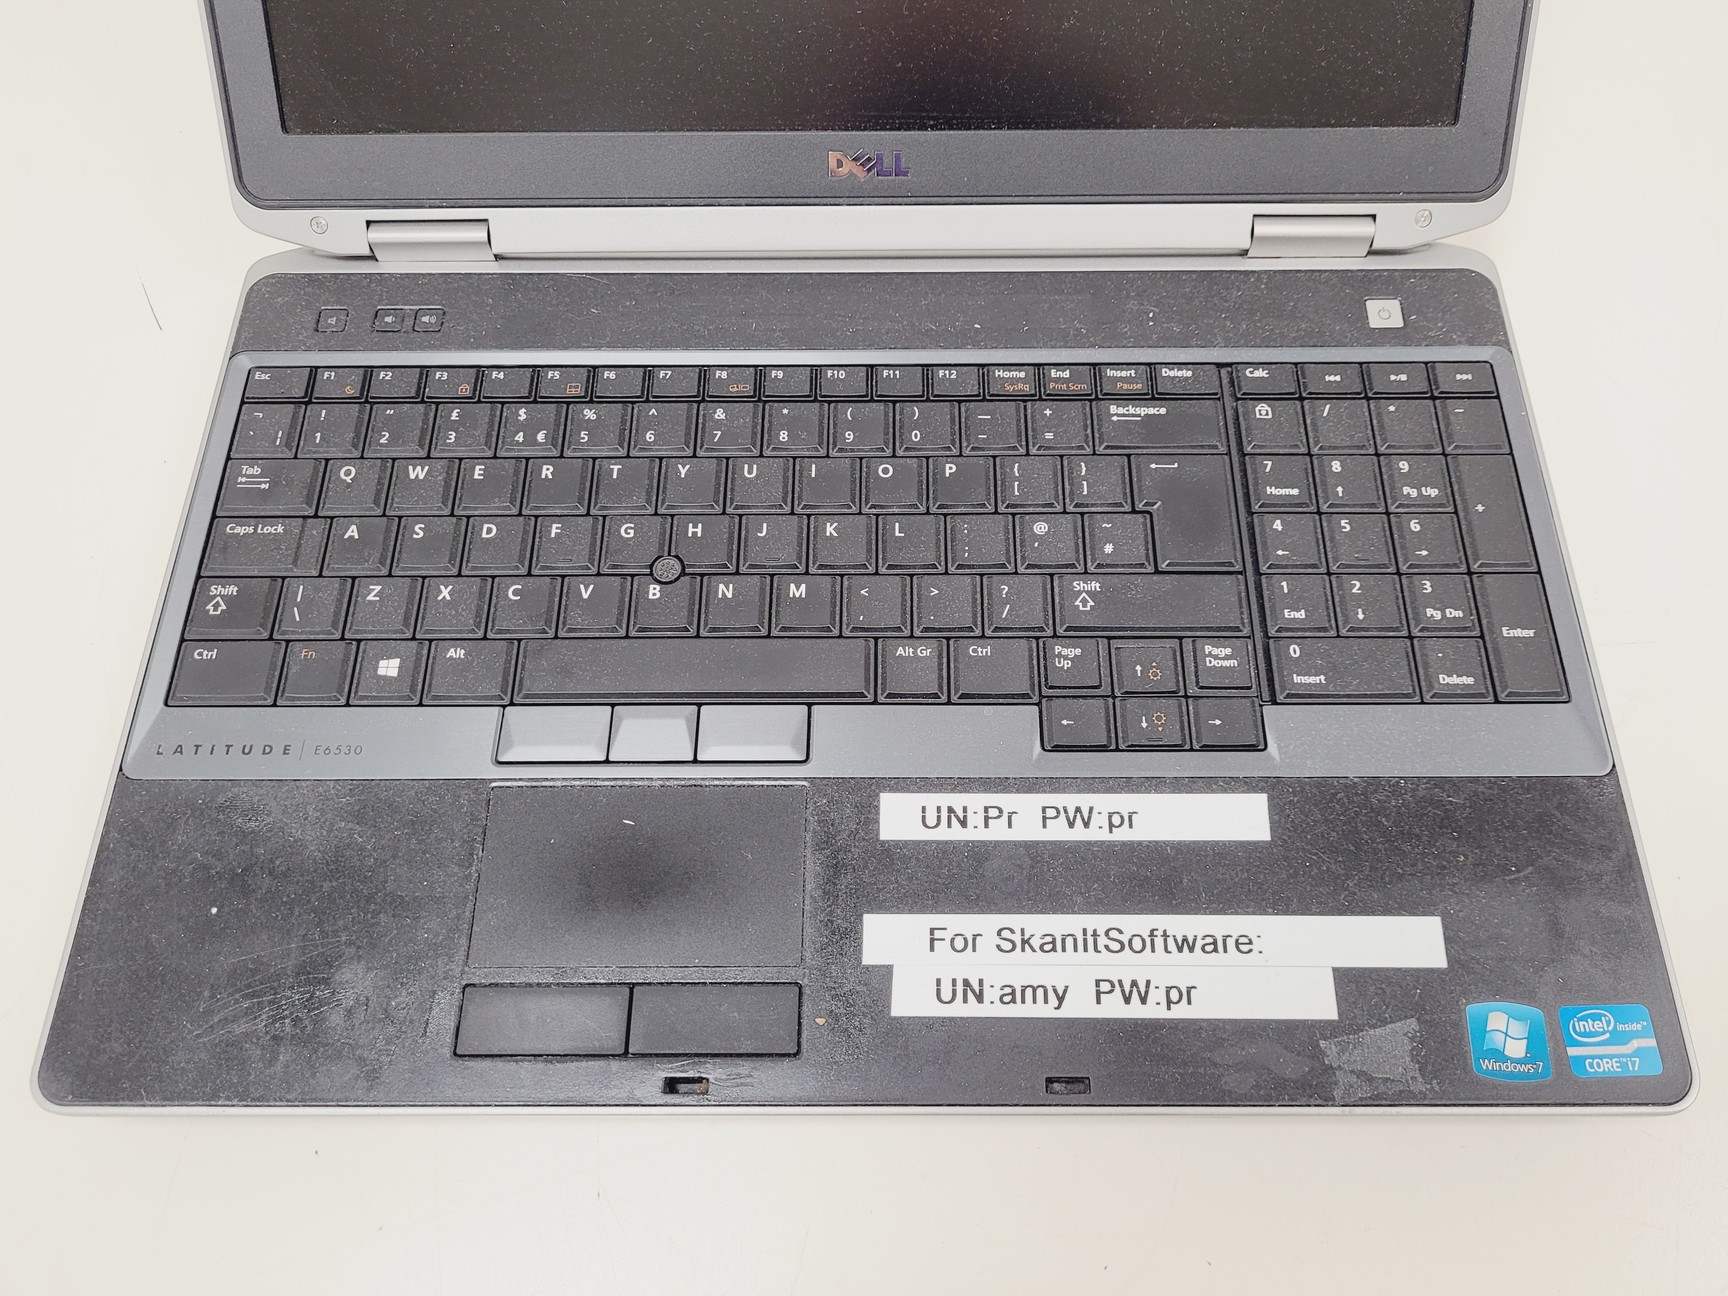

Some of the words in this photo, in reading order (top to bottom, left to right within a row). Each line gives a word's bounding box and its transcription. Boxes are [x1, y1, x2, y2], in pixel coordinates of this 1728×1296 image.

[829, 149, 910, 181] DELL
[254, 371, 272, 380] Esc
[323, 371, 336, 380] F1
[379, 371, 393, 380] F2
[435, 371, 448, 381] F3
[491, 371, 505, 380] F4
[547, 370, 561, 380] F5
[603, 370, 616, 380] F6
[659, 370, 672, 379] F7
[715, 370, 728, 379] F8
[771, 370, 784, 379] F9
[827, 369, 846, 379] F10
[883, 369, 900, 379] F11
[938, 369, 957, 379] F12
[995, 369, 1026, 378] Home
[1050, 368, 1070, 378] End
[1106, 368, 1136, 378] Insert
[1161, 367, 1193, 378] Delete
[1245, 367, 1270, 378] Calc
[1004, 382, 1030, 393] SysRq
[1049, 382, 1067, 391] Prnt
[1068, 382, 1088, 391] Scrn
[1116, 381, 1143, 390] Pause
[1109, 404, 1167, 417] Backspace
[379, 431, 390, 444] 2
[446, 431, 457, 443] 3
[514, 431, 525, 443] 4
[579, 430, 589, 443] 5
[645, 430, 655, 442] 6
[713, 430, 722, 442] 7
[779, 430, 789, 442] 8
[844, 430, 854, 443] 9
[241, 465, 262, 475] Tab
[408, 465, 430, 480] W
[473, 465, 486, 480] E
[541, 464, 554, 479] R
[609, 464, 623, 479] T
[677, 463, 691, 478] Y
[743, 463, 757, 478] U
[878, 464, 894, 478] O
[945, 463, 957, 478] P
[1262, 460, 1273, 473] 7
[1330, 460, 1342, 473] 8
[1398, 460, 1410, 473] 9
[339, 465, 356, 483] Q
[1266, 485, 1300, 496] Home
[1402, 486, 1418, 498] Pg
[1420, 486, 1439, 498] Up
[226, 523, 255, 536] Caps
[256, 523, 285, 534] Lock
[343, 524, 359, 539] A
[412, 523, 425, 539] S
[481, 523, 497, 538] D
[550, 523, 562, 538] F
[620, 523, 635, 538] G
[687, 522, 702, 538] H
[757, 522, 767, 537] J
[825, 522, 839, 537] K
[894, 522, 905, 537] L
[1272, 519, 1284, 532] 4
[1340, 519, 1351, 532] 5
[1409, 519, 1421, 532] 6
[209, 584, 239, 596] Shift
[437, 584, 454, 601] X
[507, 584, 522, 600] C
[579, 584, 595, 599] V
[648, 584, 661, 600] B
[718, 583, 733, 599] N
[789, 583, 806, 598] M
[1072, 580, 1102, 592] Shift
[1280, 580, 1288, 594] 1
[1350, 580, 1362, 594] 2
[1421, 580, 1433, 593] 3
[365, 585, 383, 601] Z
[1283, 608, 1306, 619] End
[1425, 607, 1442, 620] Pg
[1445, 608, 1464, 618] Dn
[1501, 626, 1536, 638] Enter
[193, 648, 218, 660] Ctrl
[299, 648, 316, 660] Fn
[445, 647, 466, 659] Alt
[895, 646, 915, 657] Alt
[916, 646, 932, 657] Gr
[969, 645, 991, 657] Ctrl
[1054, 645, 1082, 658] Page
[1204, 645, 1233, 658] Page
[1055, 657, 1072, 670] Up
[1205, 657, 1238, 667] Down
[1292, 673, 1327, 684] Insert
[1438, 674, 1475, 685] Delete
[156, 744, 291, 755] LATITUDE
[314, 745, 363, 755] E6530
[920, 804, 1019, 830] UN:Pr
[1040, 804, 1139, 835] PW:pr
[928, 926, 983, 954] For
[934, 977, 1069, 1010] UN:amy
[1094, 978, 1197, 1011] PW:pr
[1536, 1062, 1543, 1073] 7
